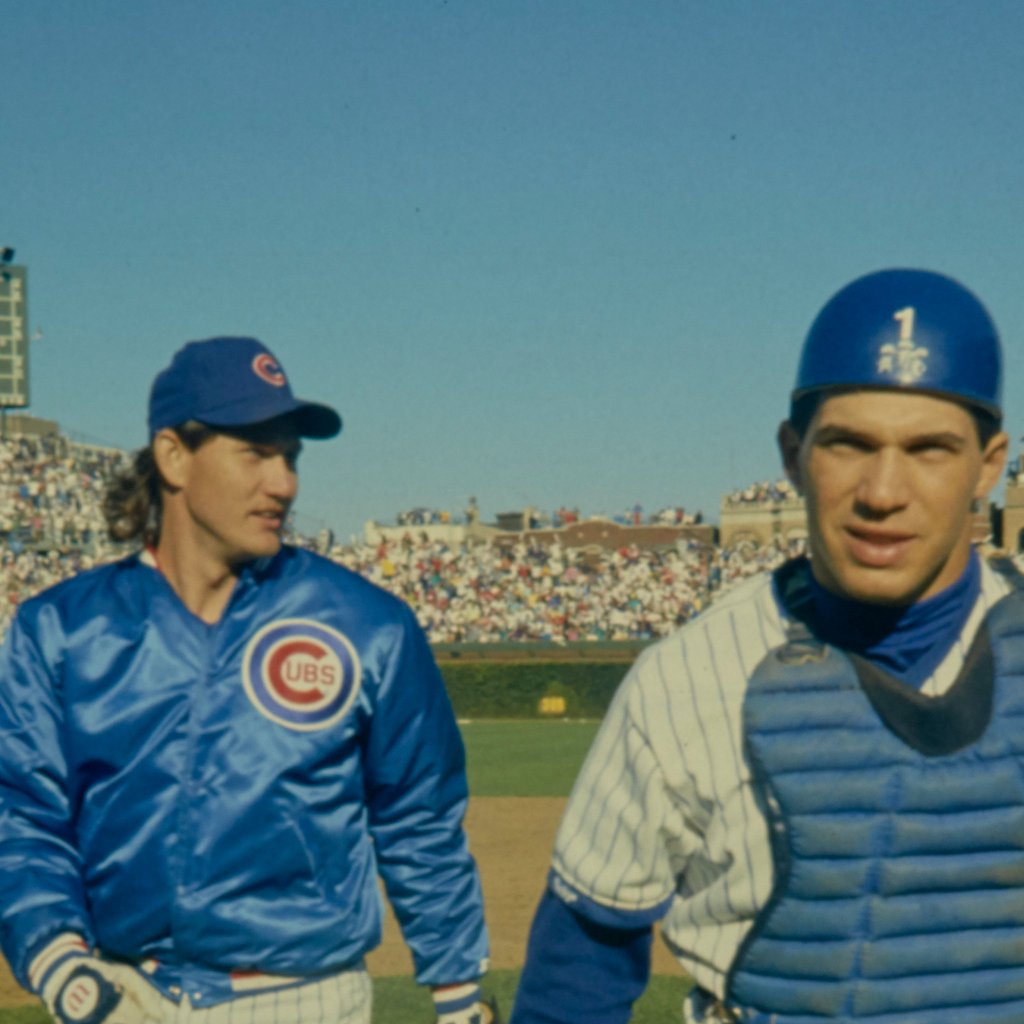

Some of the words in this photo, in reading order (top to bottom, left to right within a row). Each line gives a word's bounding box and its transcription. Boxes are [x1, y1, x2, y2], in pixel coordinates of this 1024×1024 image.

[893, 306, 915, 349] 1
[252, 353, 285, 387] C
[267, 640, 336, 705] CUBS
